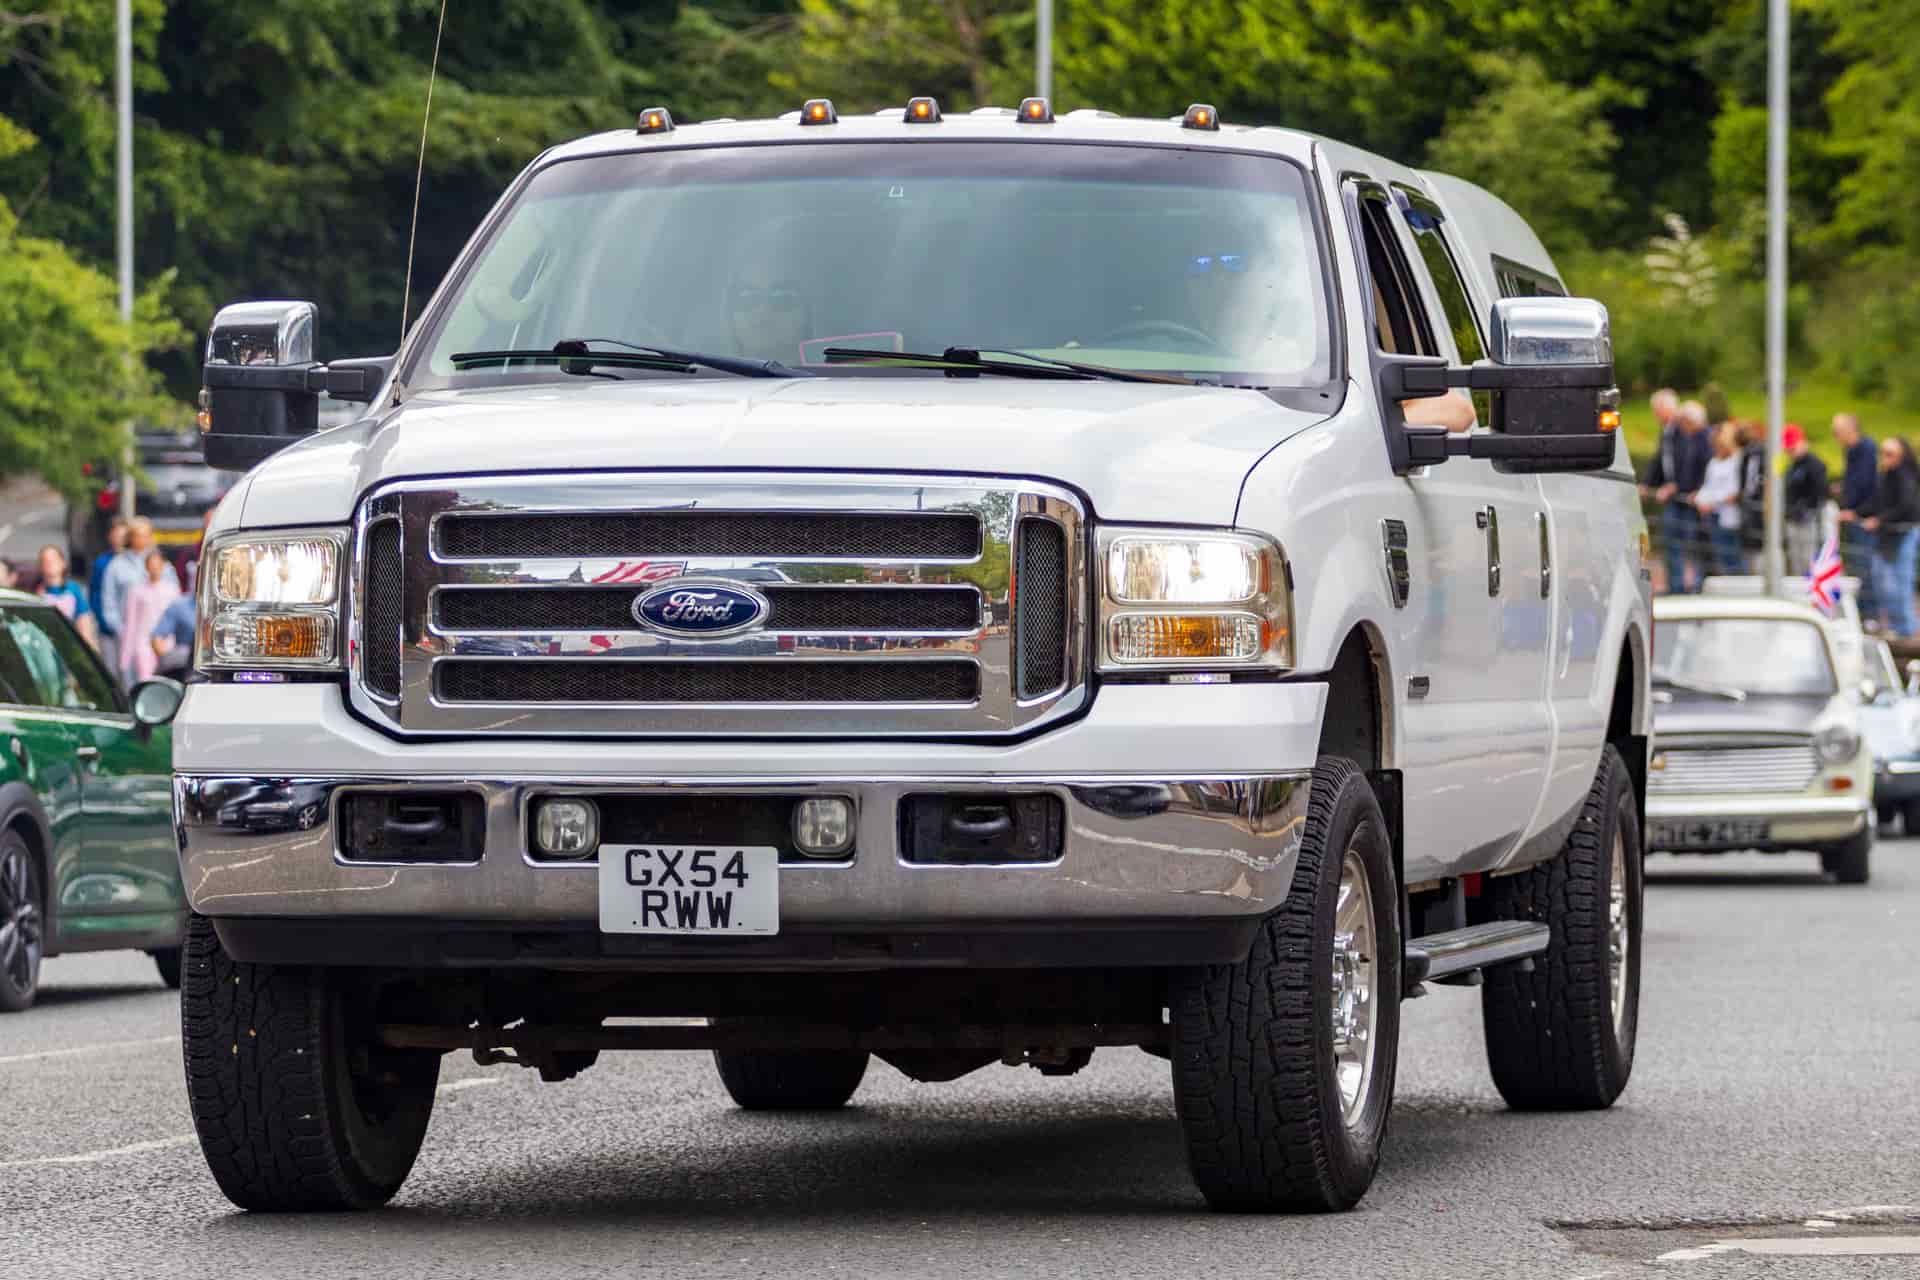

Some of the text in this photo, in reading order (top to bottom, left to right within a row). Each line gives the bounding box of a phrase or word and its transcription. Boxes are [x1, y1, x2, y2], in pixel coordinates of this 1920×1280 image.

[662, 591, 735, 622] Ford
[625, 849, 749, 888] GX54
[641, 889, 733, 929] RWW
